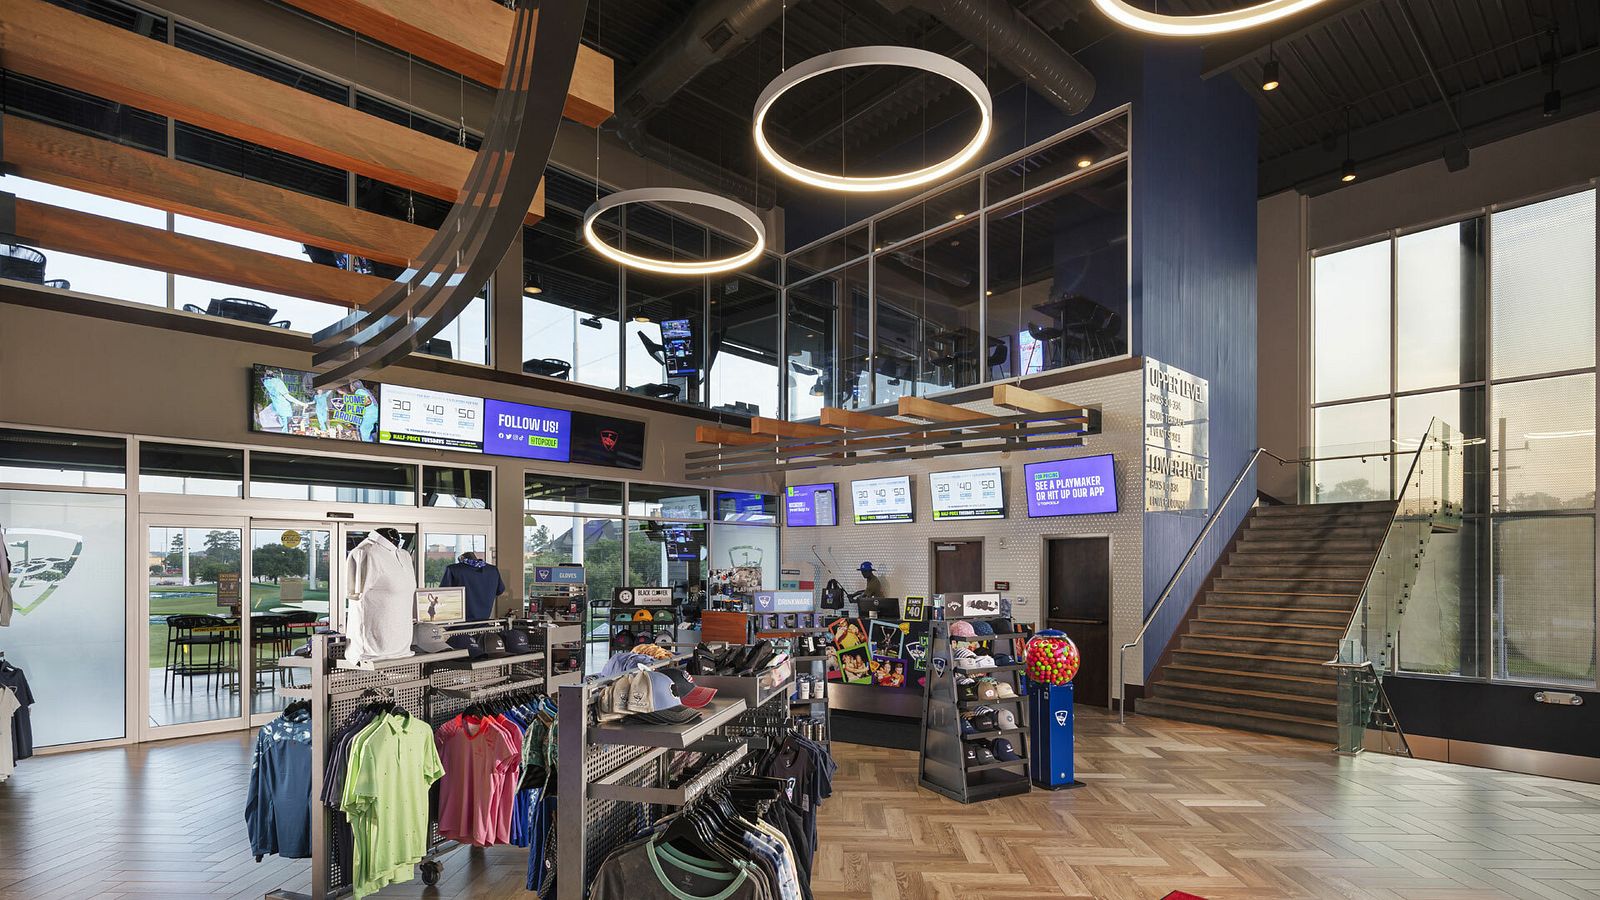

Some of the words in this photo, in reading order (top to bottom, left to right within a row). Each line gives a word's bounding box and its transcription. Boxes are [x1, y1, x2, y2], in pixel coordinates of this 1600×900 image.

[1150, 368, 1178, 395] UPPER
[1180, 379, 1204, 404] LEVEL
[343, 394, 365, 404] COME
[334, 410, 364, 425] AROUND
[347, 405, 364, 415] PLAY
[498, 413, 540, 431] FOLLOW
[542, 420, 559, 434] US!
[530, 436, 557, 447] @TOPGOLF
[1150, 454, 1179, 477] LOWER
[1180, 461, 1206, 481] LEVEL
[1035, 480, 1048, 491] SEE
[1049, 480, 1055, 490] A
[1056, 476, 1101, 489] PLAYMAKER
[1036, 491, 1046, 501] OR
[1047, 490, 1059, 500] HIT
[1060, 489, 1070, 499] UP
[1072, 488, 1088, 498] OUR
[1089, 486, 1105, 497] APP
